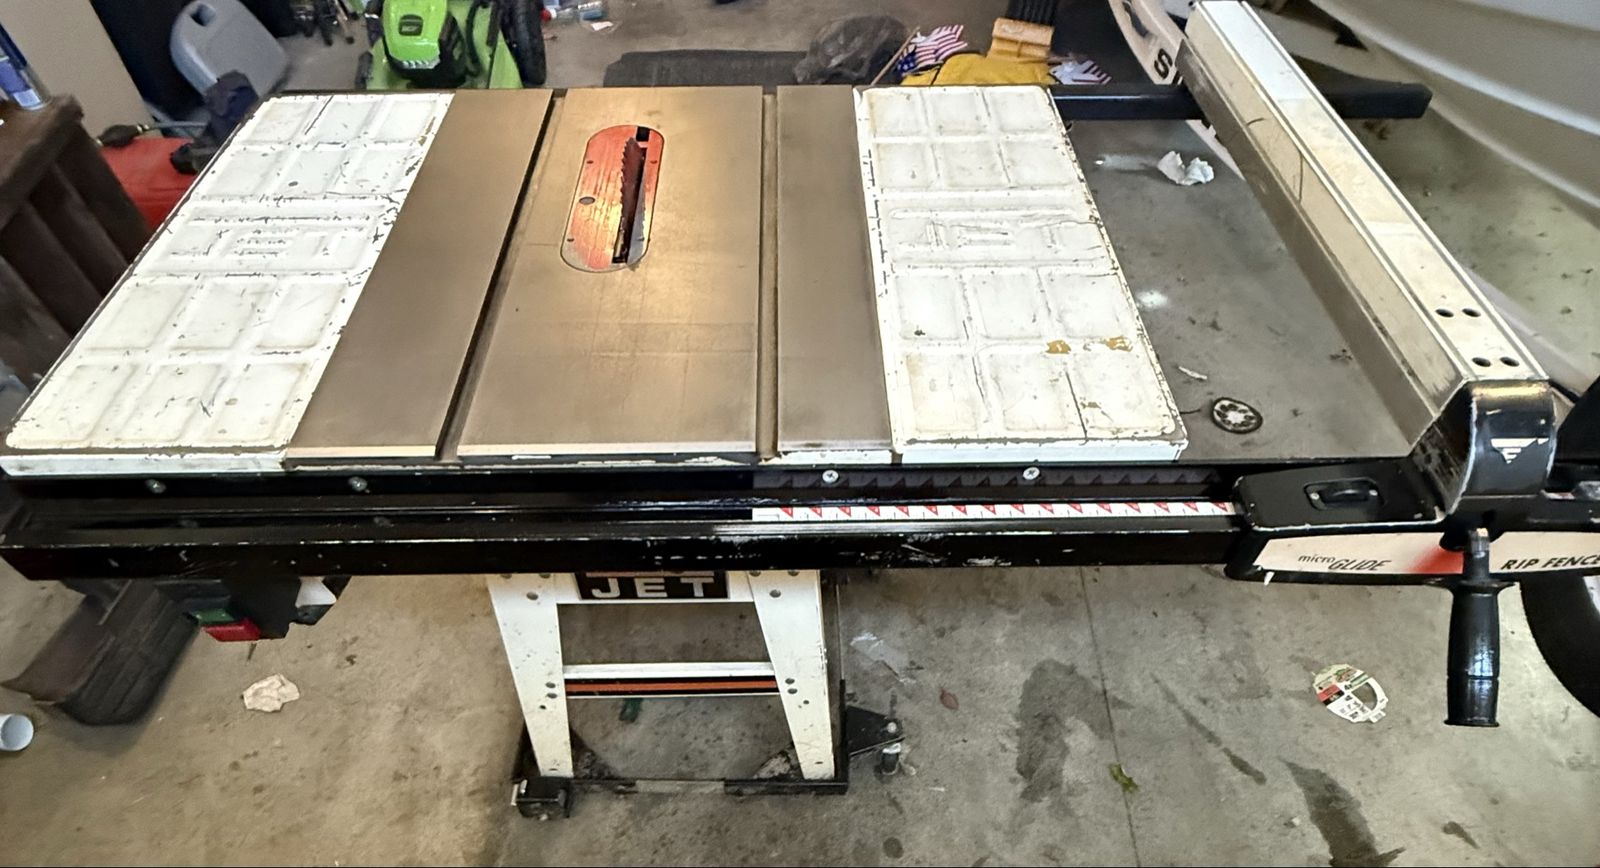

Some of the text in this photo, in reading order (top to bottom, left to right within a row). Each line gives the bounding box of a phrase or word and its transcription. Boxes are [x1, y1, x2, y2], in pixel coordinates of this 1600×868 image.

[1327, 558, 1392, 571] GLIDE
[1500, 559, 1540, 570] RIP
[590, 577, 715, 599] JET
